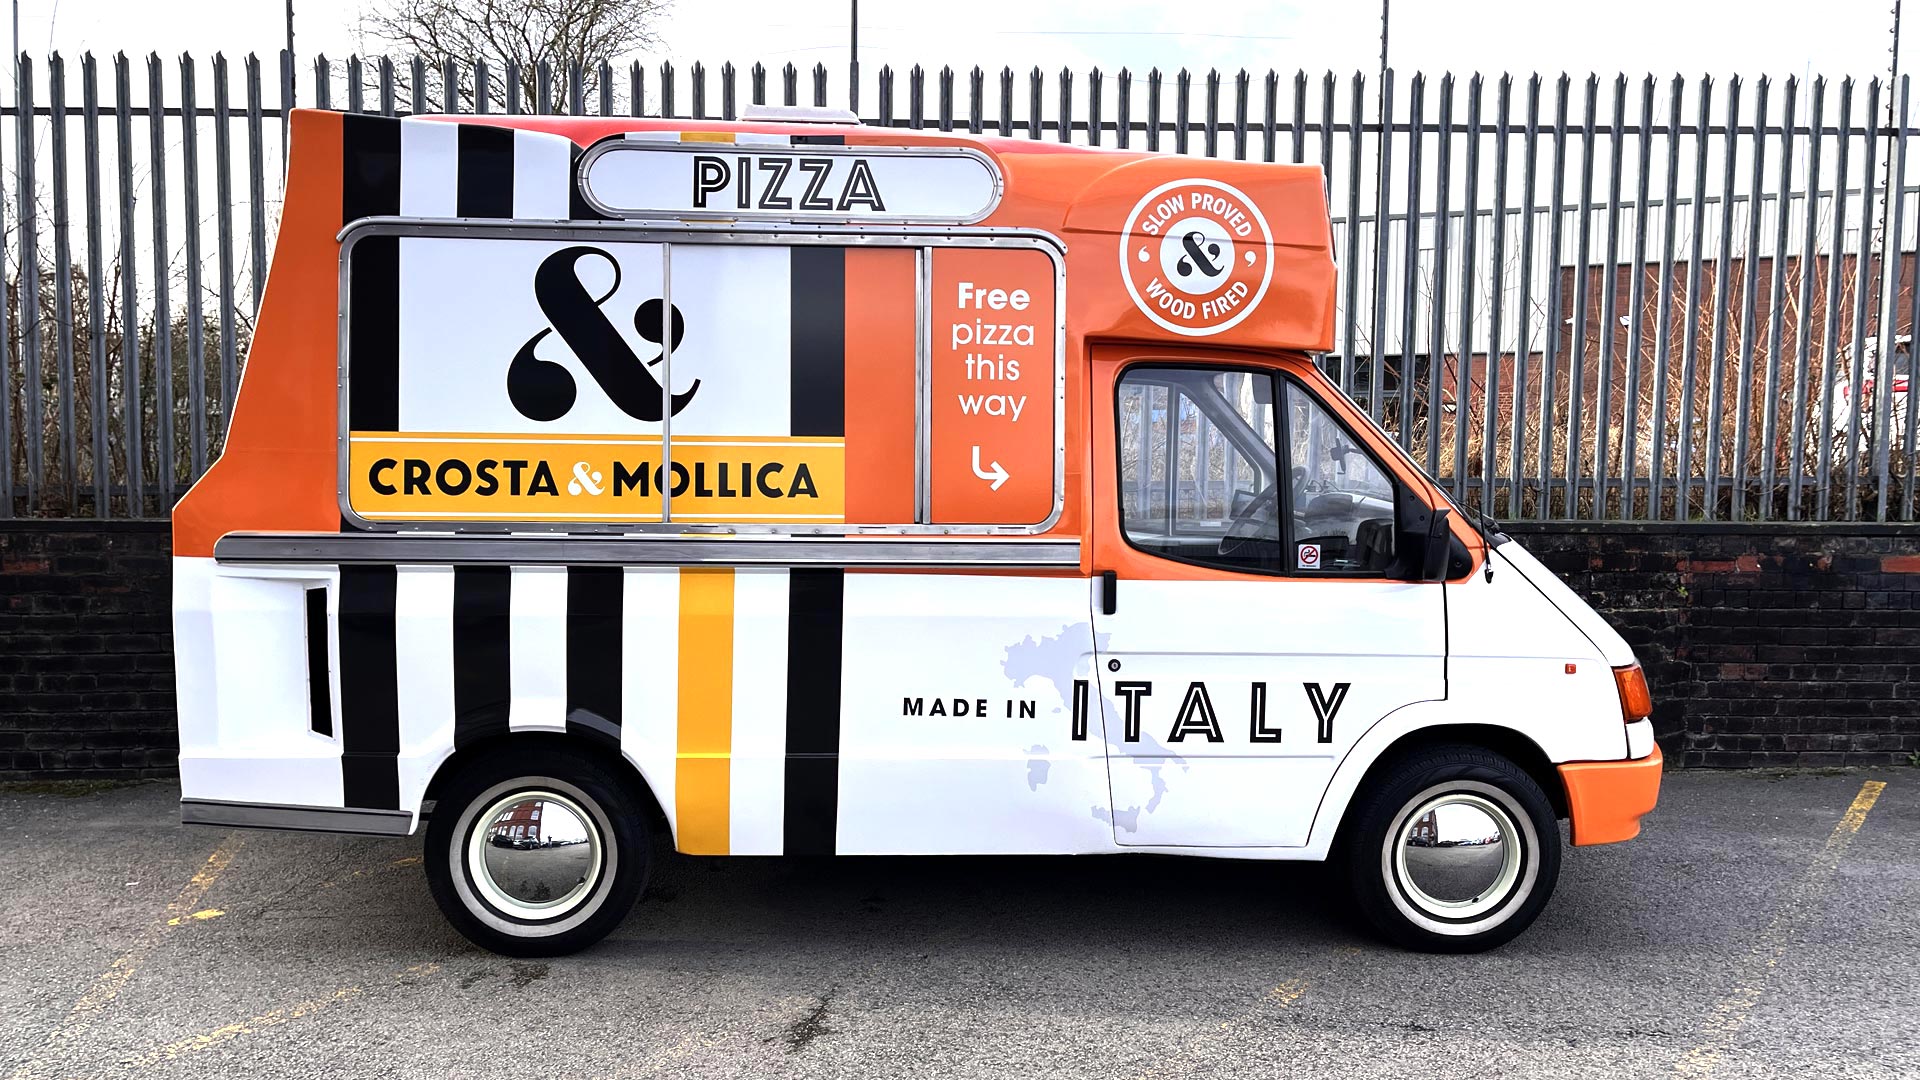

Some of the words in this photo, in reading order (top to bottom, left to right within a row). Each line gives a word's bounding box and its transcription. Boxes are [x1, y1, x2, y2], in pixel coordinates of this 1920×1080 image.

[693, 156, 886, 212] PIZZA
[1142, 194, 1185, 236] SLOW
[1191, 192, 1252, 237] PROVED
[1176, 231, 1225, 277] &
[957, 282, 1031, 311] Free
[1145, 277, 1196, 320] WOOD
[1201, 281, 1248, 320] FIRED
[507, 245, 701, 422] &
[952, 319, 1035, 350] pizza
[965, 353, 1020, 382] this
[958, 392, 1027, 421] way
[368, 458, 559, 497] CROSTA
[567, 461, 606, 497] &
[613, 461, 819, 499] MOLLICA
[902, 697, 988, 718] MADE
[1006, 699, 1037, 719] IN
[1072, 679, 1351, 744] ITALY
